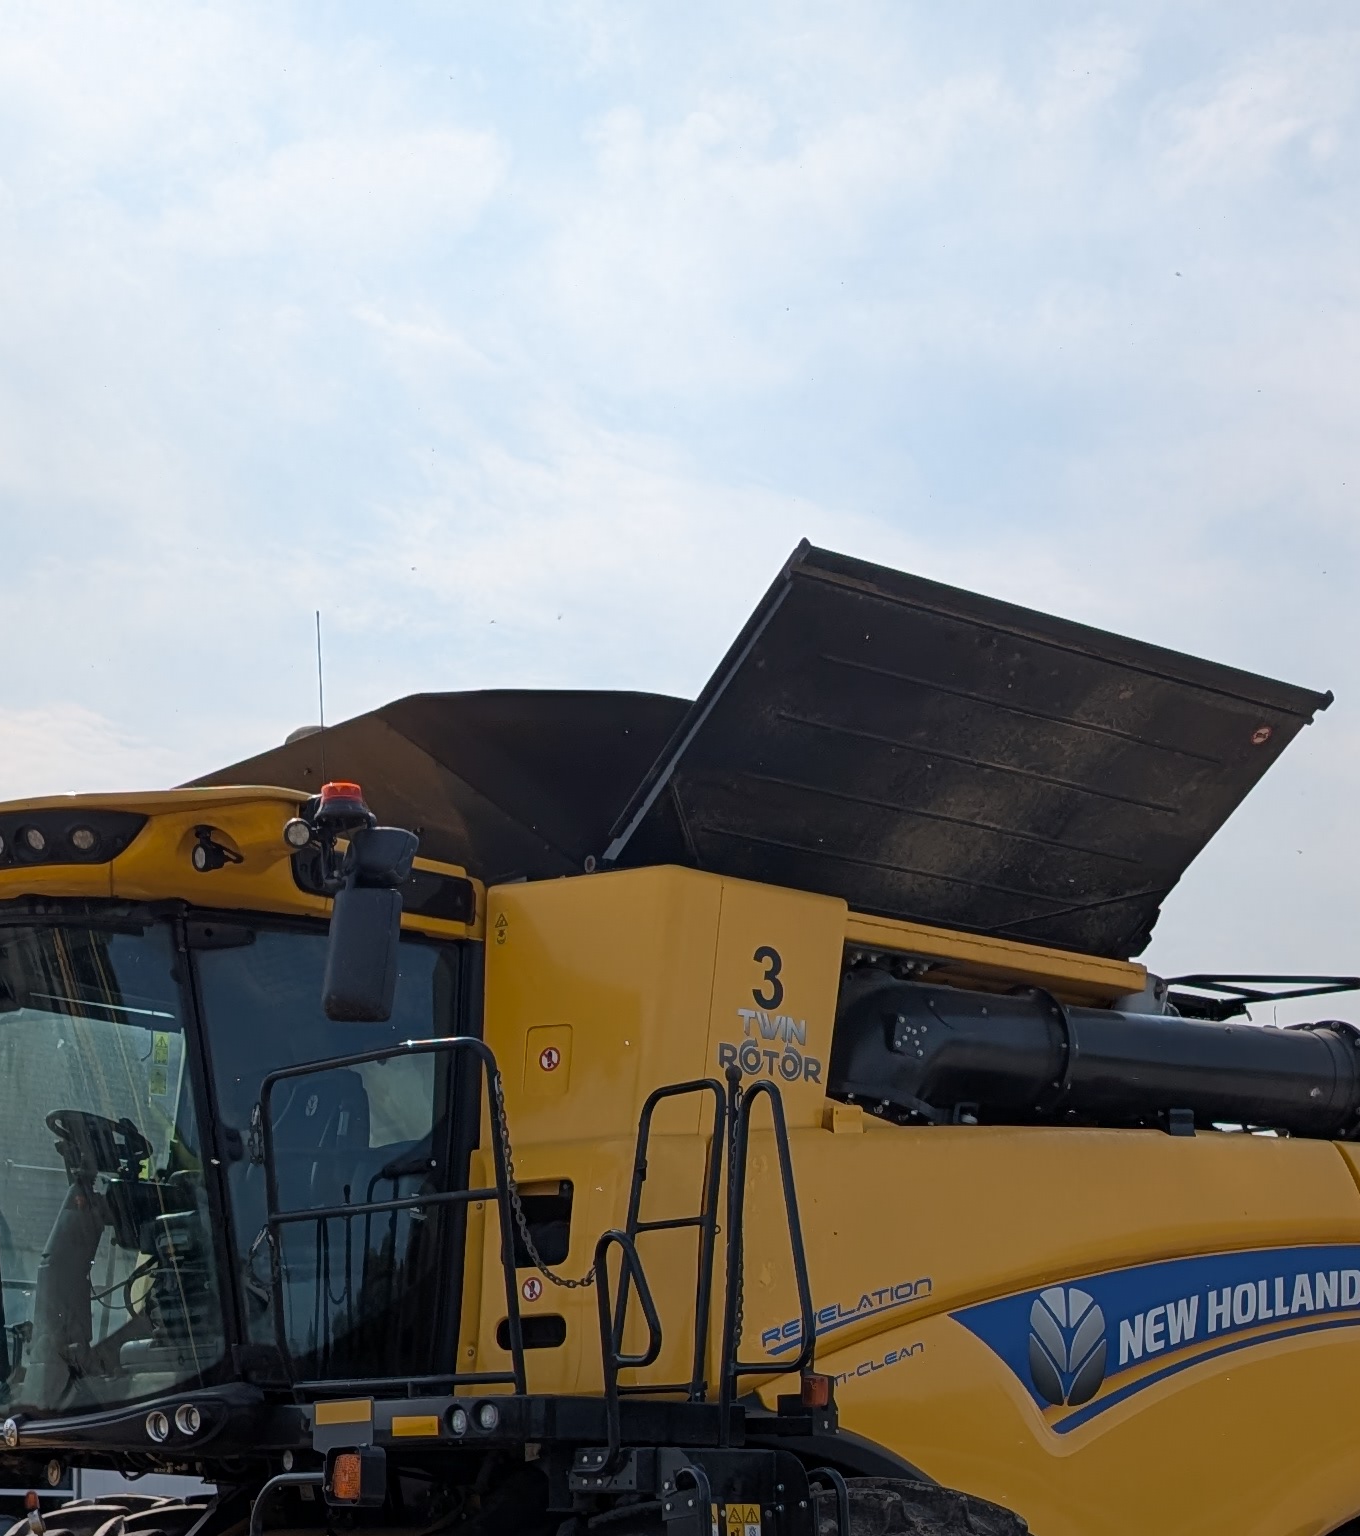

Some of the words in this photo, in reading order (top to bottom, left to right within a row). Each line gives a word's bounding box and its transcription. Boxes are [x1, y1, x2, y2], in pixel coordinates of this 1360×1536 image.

[752, 945, 784, 1010] 3
[736, 1008, 807, 1046] TWIN
[719, 1038, 822, 1084] ROTOR
[761, 1277, 932, 1348] REELATION
[1118, 1294, 1200, 1366] NEW
